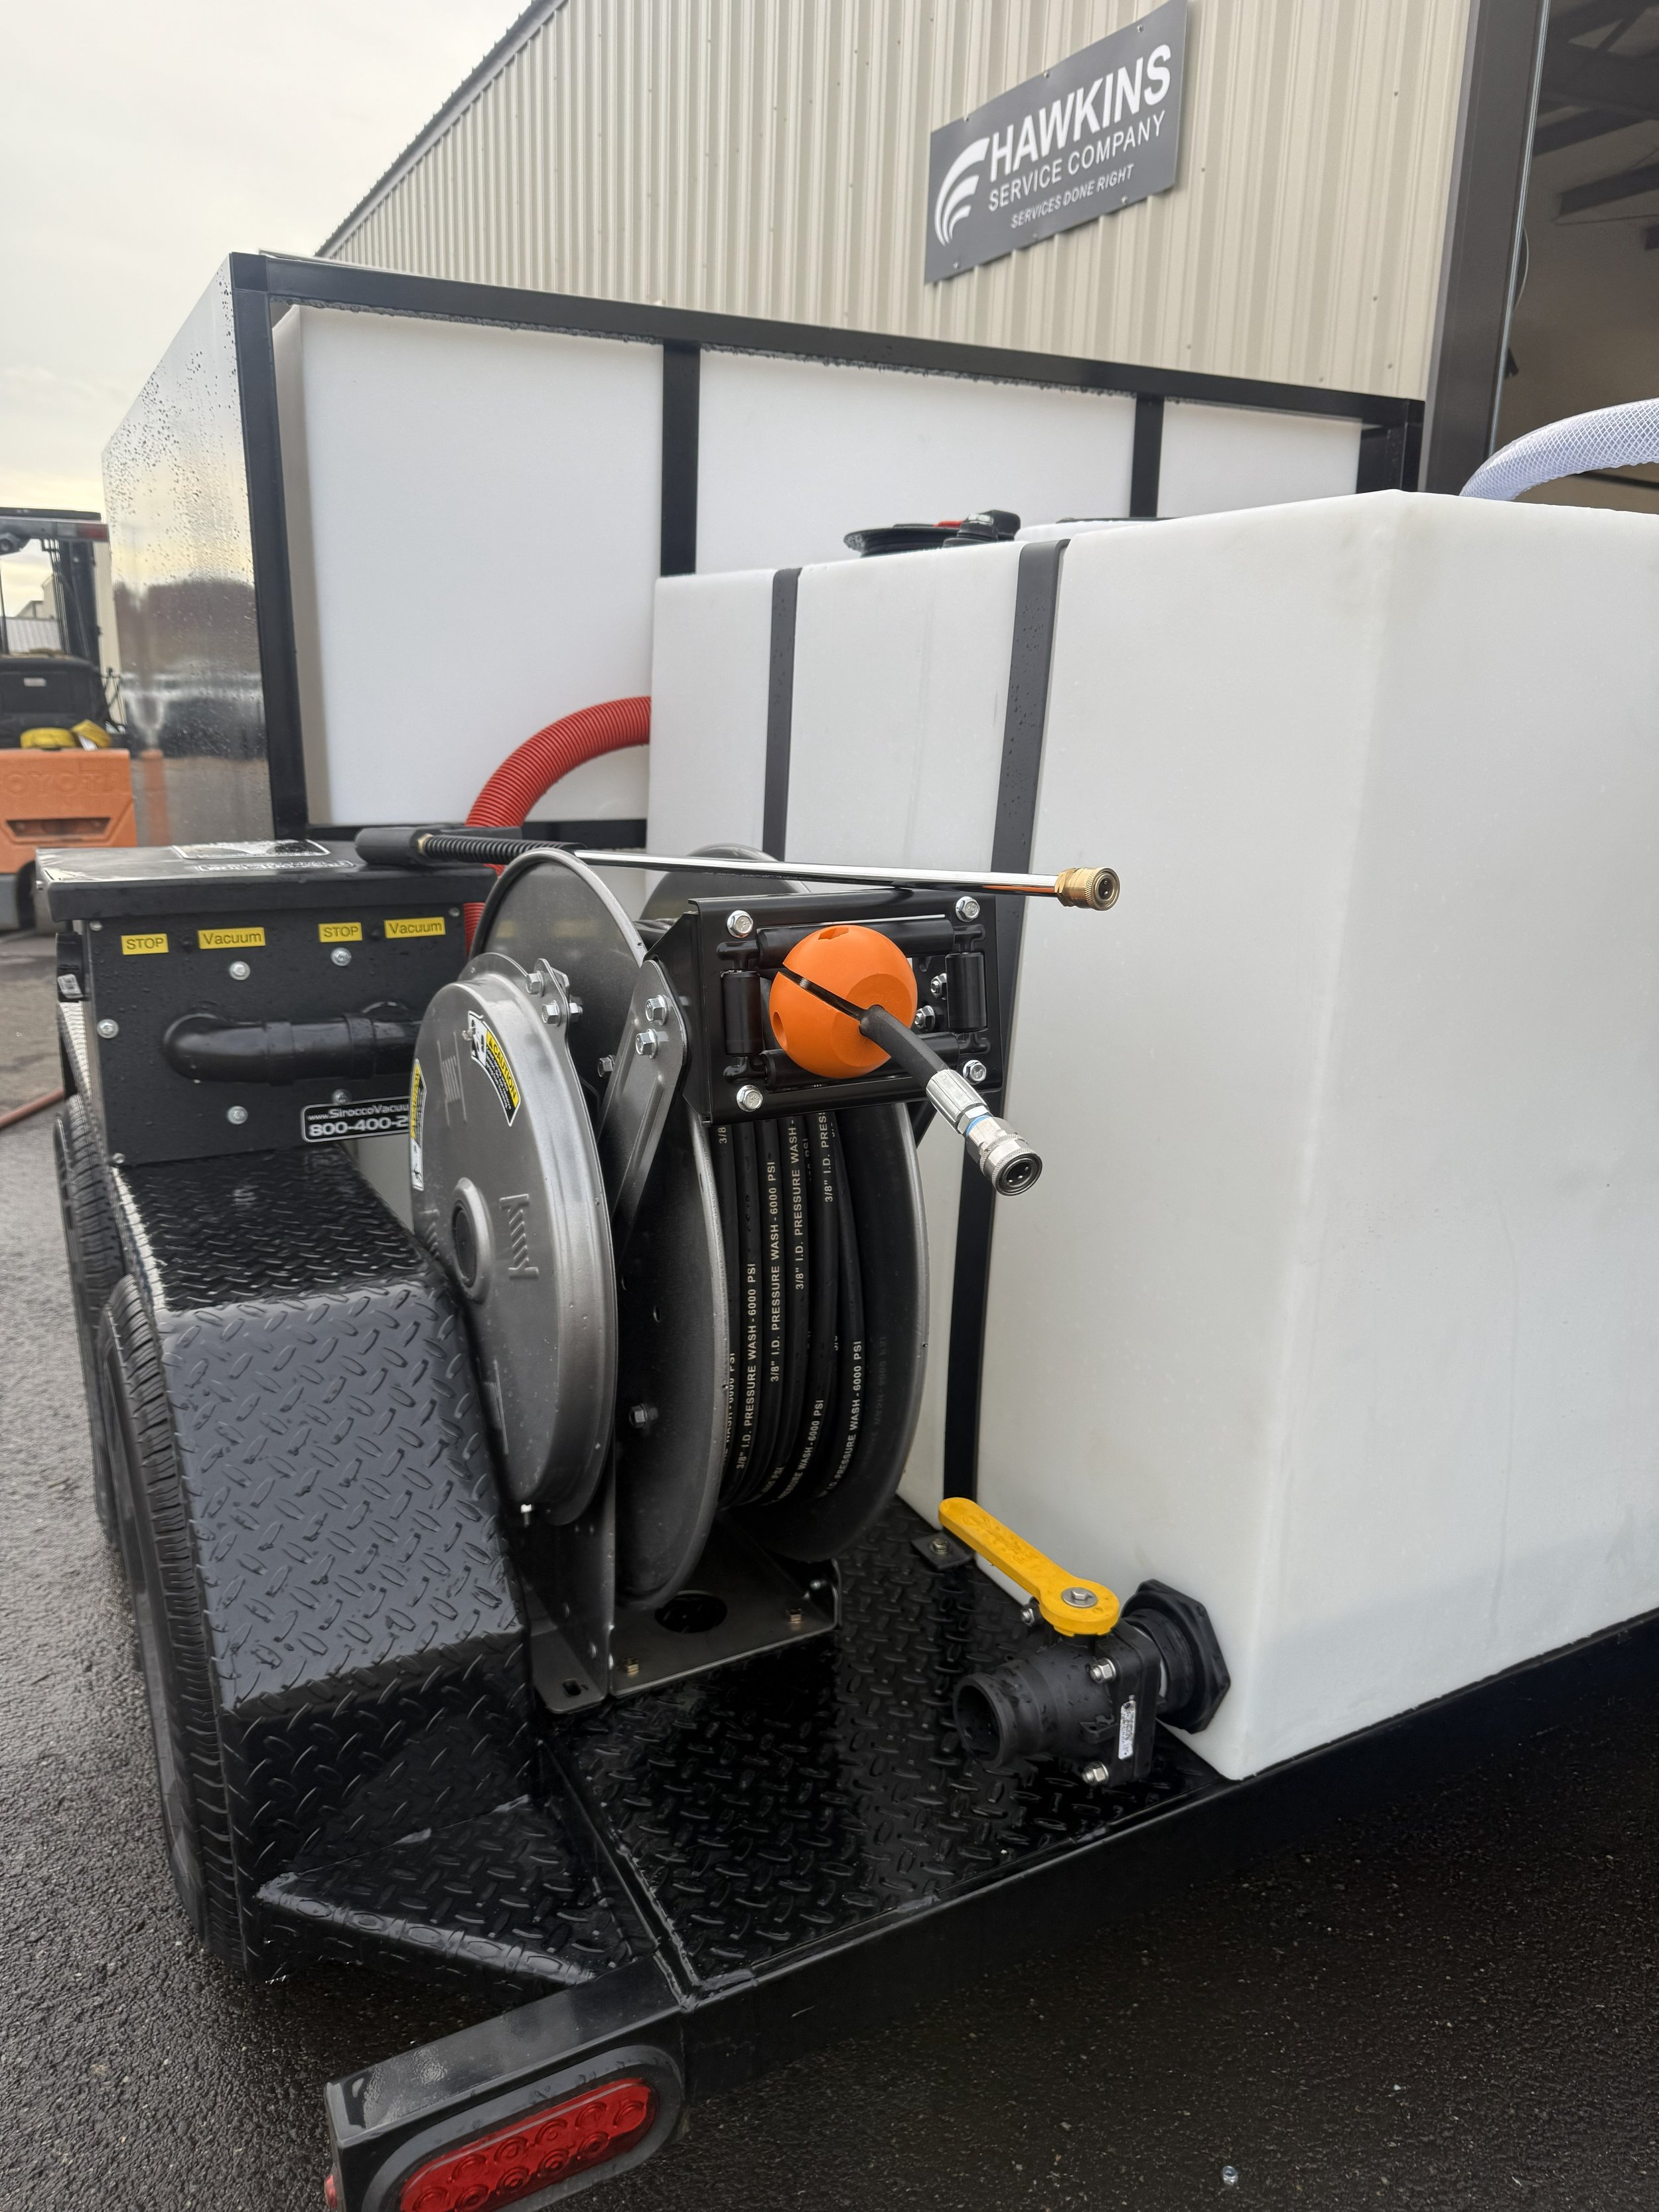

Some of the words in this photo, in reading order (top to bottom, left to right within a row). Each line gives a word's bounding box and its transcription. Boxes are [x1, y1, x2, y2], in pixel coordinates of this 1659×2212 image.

[989, 44, 1171, 182] HAWKINS
[988, 159, 1062, 212] SERVICE
[1068, 110, 1165, 175] COMPANY
[1011, 196, 1061, 229] SERVICES
[1062, 180, 1094, 206] DONE
[1097, 163, 1134, 190] RIGHT
[203, 931, 262, 945] Vacuum
[323, 926, 359, 938] STOP
[390, 921, 443, 934] Vacuum
[126, 937, 164, 951] STOP
[493, 1043, 516, 1099] CAUTION
[788, 1128, 799, 1163] WASH
[767, 1162, 776, 1181] PSI
[823, 1154, 831, 1173] I.D.
[769, 1187, 778, 1215] 6000
[792, 1169, 803, 1236] PRESSURE
[824, 1180, 833, 1203] 3/8"
[770, 1224, 780, 1260] WASH
[748, 1325, 757, 1361] WASH
[771, 1337, 780, 1355] I.D.
[770, 1361, 779, 1382] 3/8"
[853, 1366, 861, 1391] 6000
[744, 1365, 756, 1426] PRESSURE
[849, 1399, 860, 1431] WASH
[742, 1431, 751, 1447] I.D.
[798, 1447, 813, 1471] WASH
[808, 1421, 820, 1441] 6000
[814, 1400, 824, 1416] PSI
[737, 1451, 747, 1469] 3/8"
[835, 1434, 856, 1479] PRESSURE
